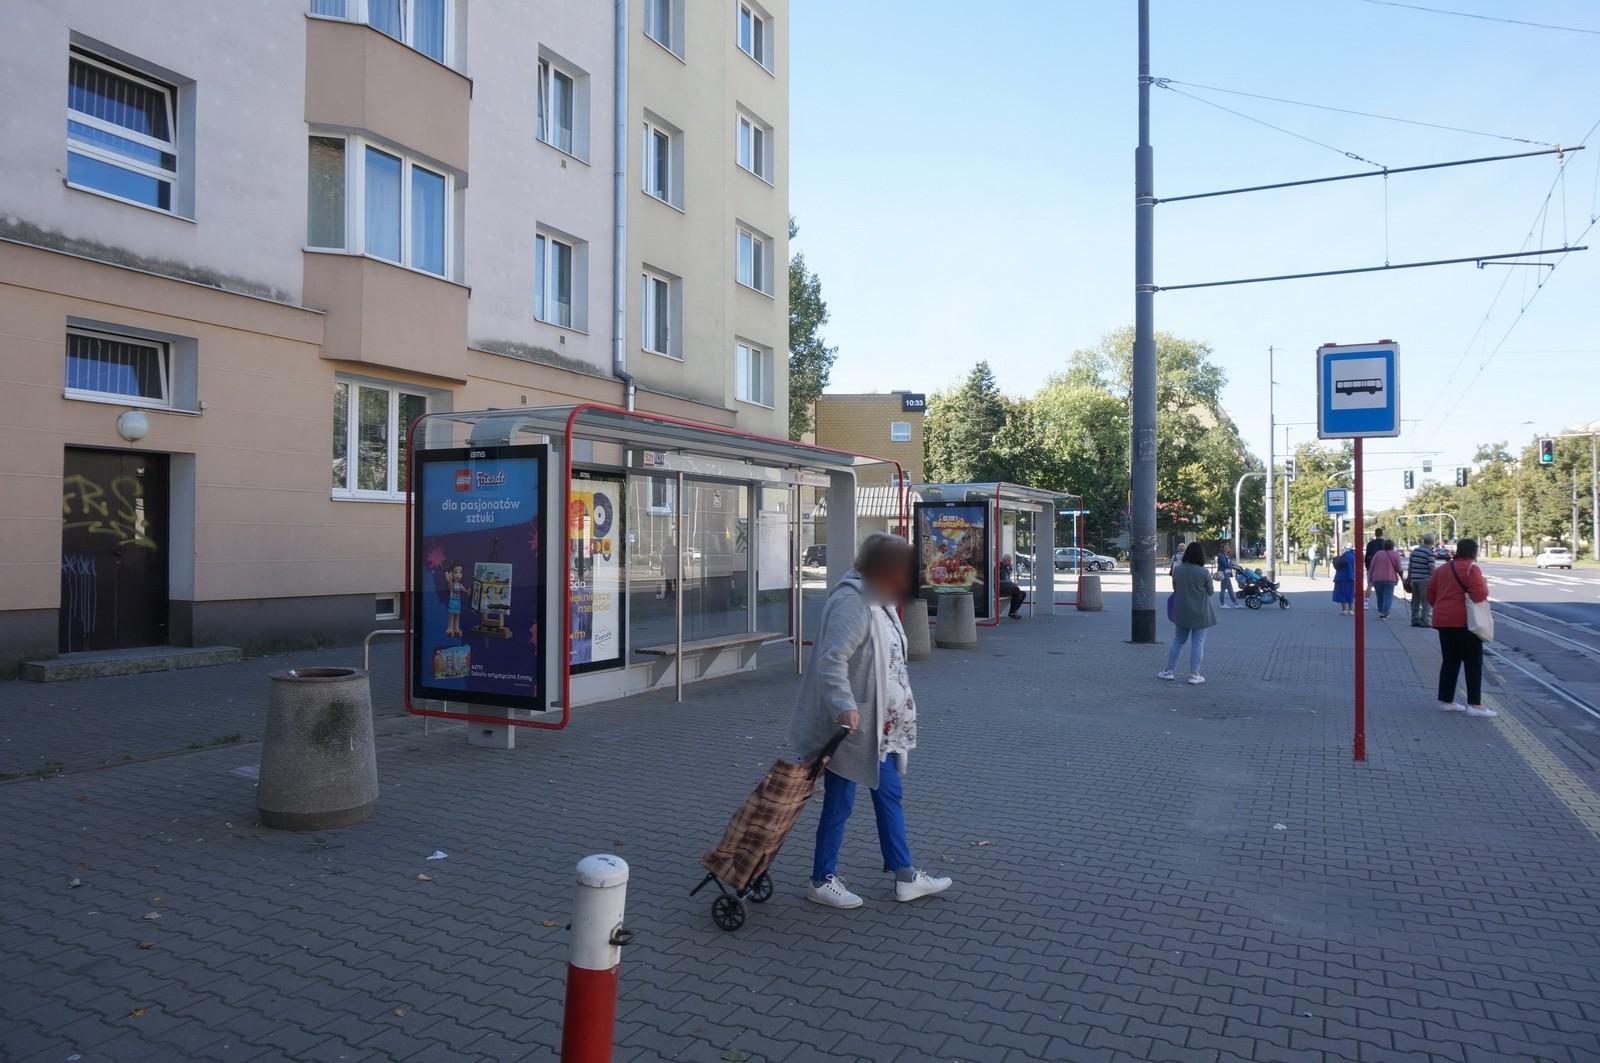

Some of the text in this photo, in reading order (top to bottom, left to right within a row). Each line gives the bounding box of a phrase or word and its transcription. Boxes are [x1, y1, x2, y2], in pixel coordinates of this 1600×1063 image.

[905, 399, 924, 407] 10:33
[441, 497, 520, 512] dla pasjonatów
[465, 511, 495, 523] sztuki
